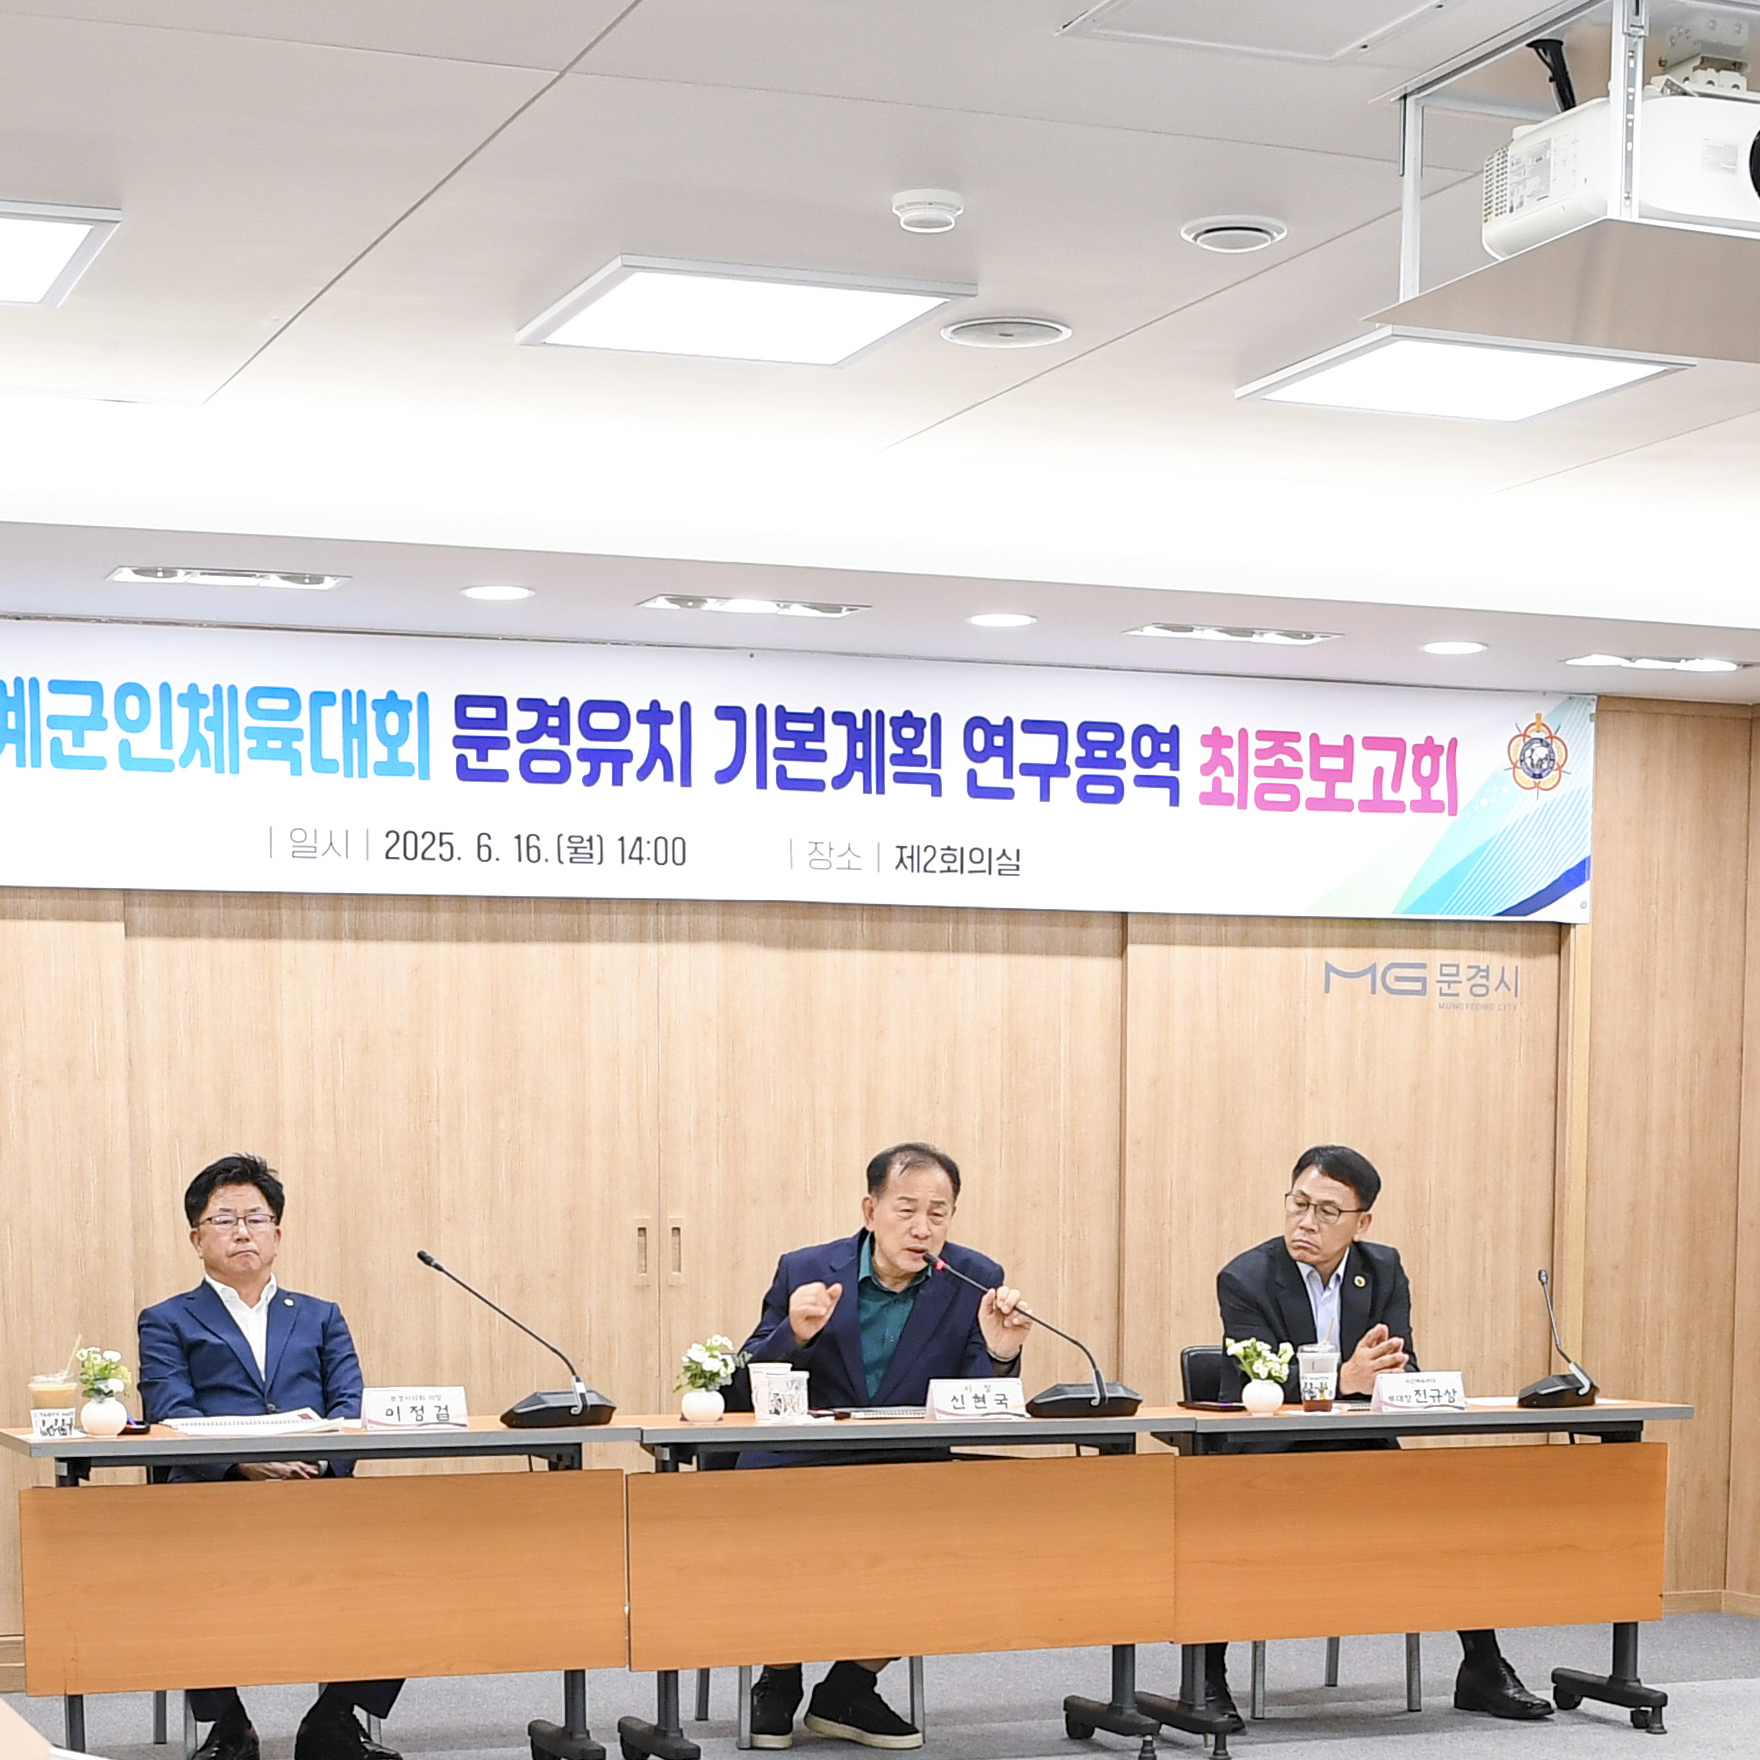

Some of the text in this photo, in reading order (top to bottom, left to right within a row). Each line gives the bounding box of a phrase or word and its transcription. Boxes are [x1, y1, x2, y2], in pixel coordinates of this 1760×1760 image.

[452, 694, 693, 788] 문경유치
[713, 702, 943, 798] 기본계획
[963, 715, 1181, 807] 연구용역
[1198, 725, 1459, 817] 최종보고회
[289, 828, 349, 859] 일시
[384, 829, 462, 862] 2025.
[476, 832, 501, 863] 6.
[617, 835, 687, 866] 14:00
[807, 841, 1021, 876] 장소 제2회의실
[1324, 961, 1428, 997] MG
[1436, 963, 1520, 998] 문경시
[950, 1393, 1009, 1410] 신현국
[1414, 1387, 1458, 1404] 진규상
